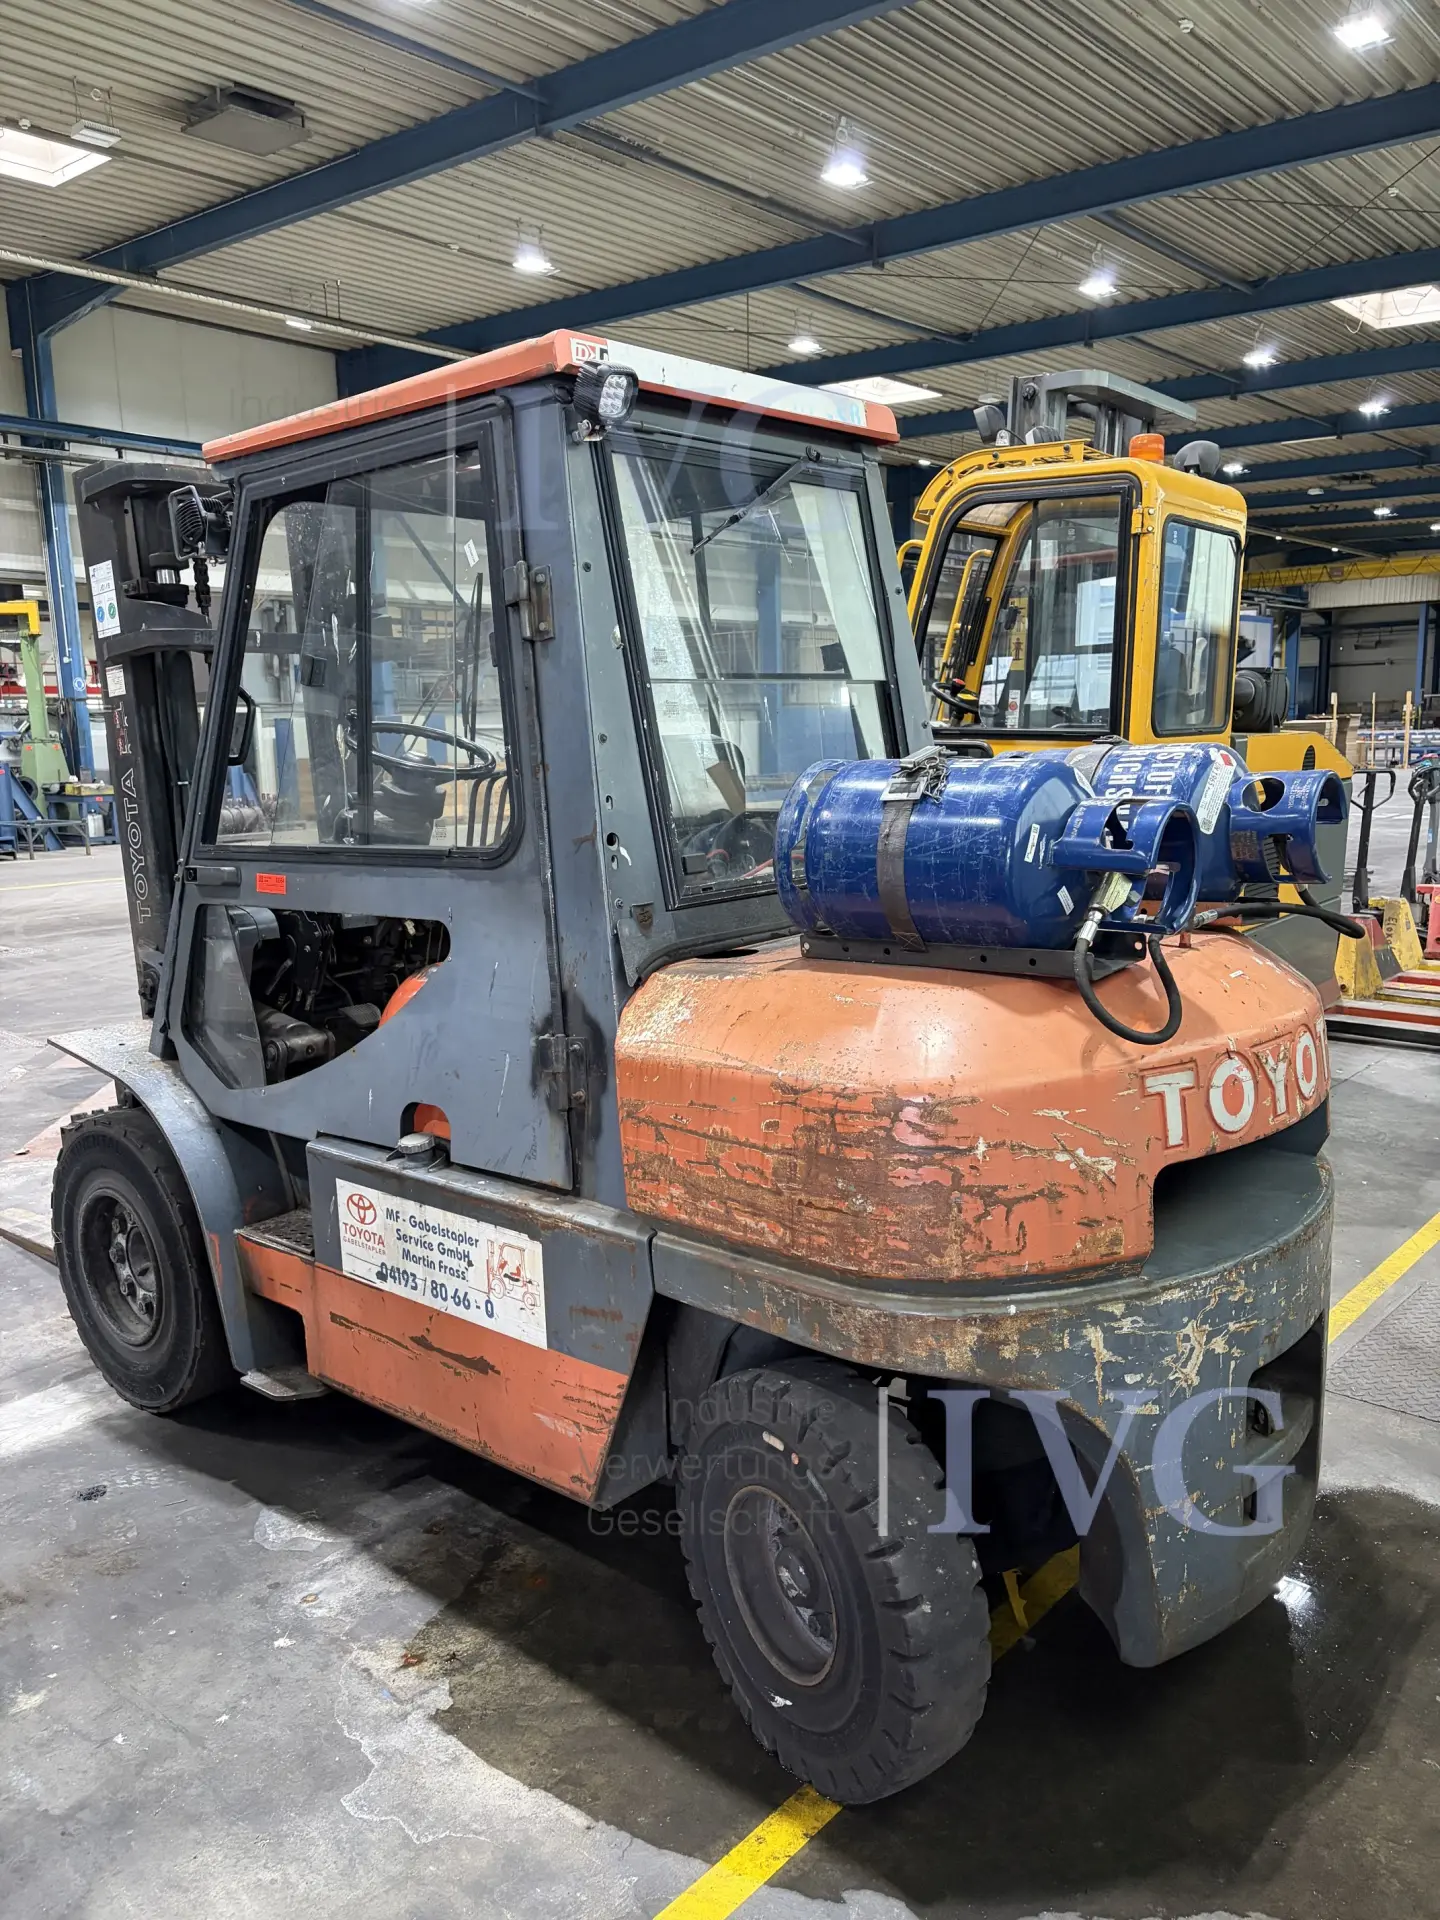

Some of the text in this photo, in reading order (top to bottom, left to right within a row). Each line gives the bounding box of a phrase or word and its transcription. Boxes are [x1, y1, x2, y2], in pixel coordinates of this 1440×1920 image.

[121, 767, 151, 924] TOYOTA
[342, 1222, 386, 1248] TOYOTA
[385, 1207, 401, 1223] MF
[409, 1214, 480, 1248] Gabelstapler
[343, 1237, 386, 1256] GABELSTAPLER
[395, 1228, 471, 1262] Service GmbH
[402, 1248, 467, 1282] Martin Frass
